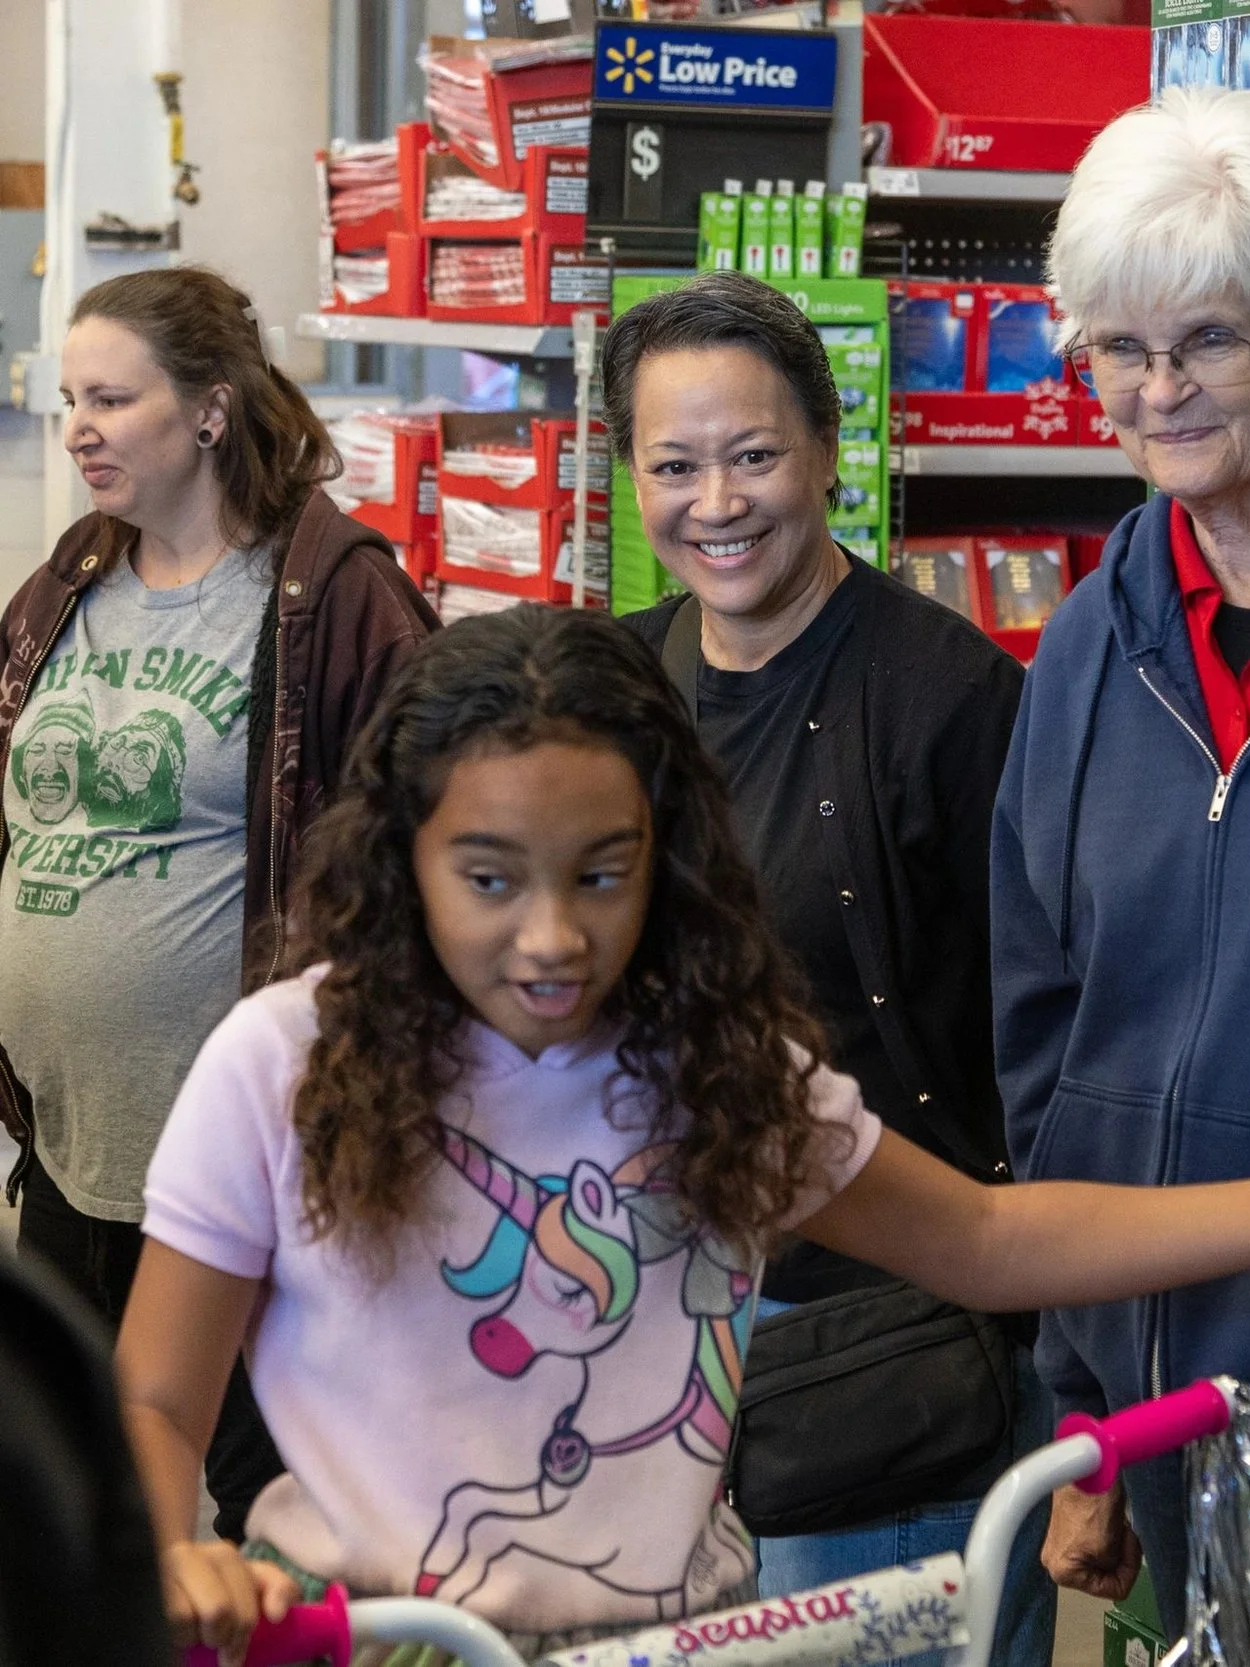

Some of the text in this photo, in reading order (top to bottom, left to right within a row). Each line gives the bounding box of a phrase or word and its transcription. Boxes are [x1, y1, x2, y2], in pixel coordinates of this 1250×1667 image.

[660, 41, 714, 59] Everyday
[659, 55, 797, 88] Low Price
[631, 126, 660, 182] $
[928, 422, 1014, 442] Inspirational
